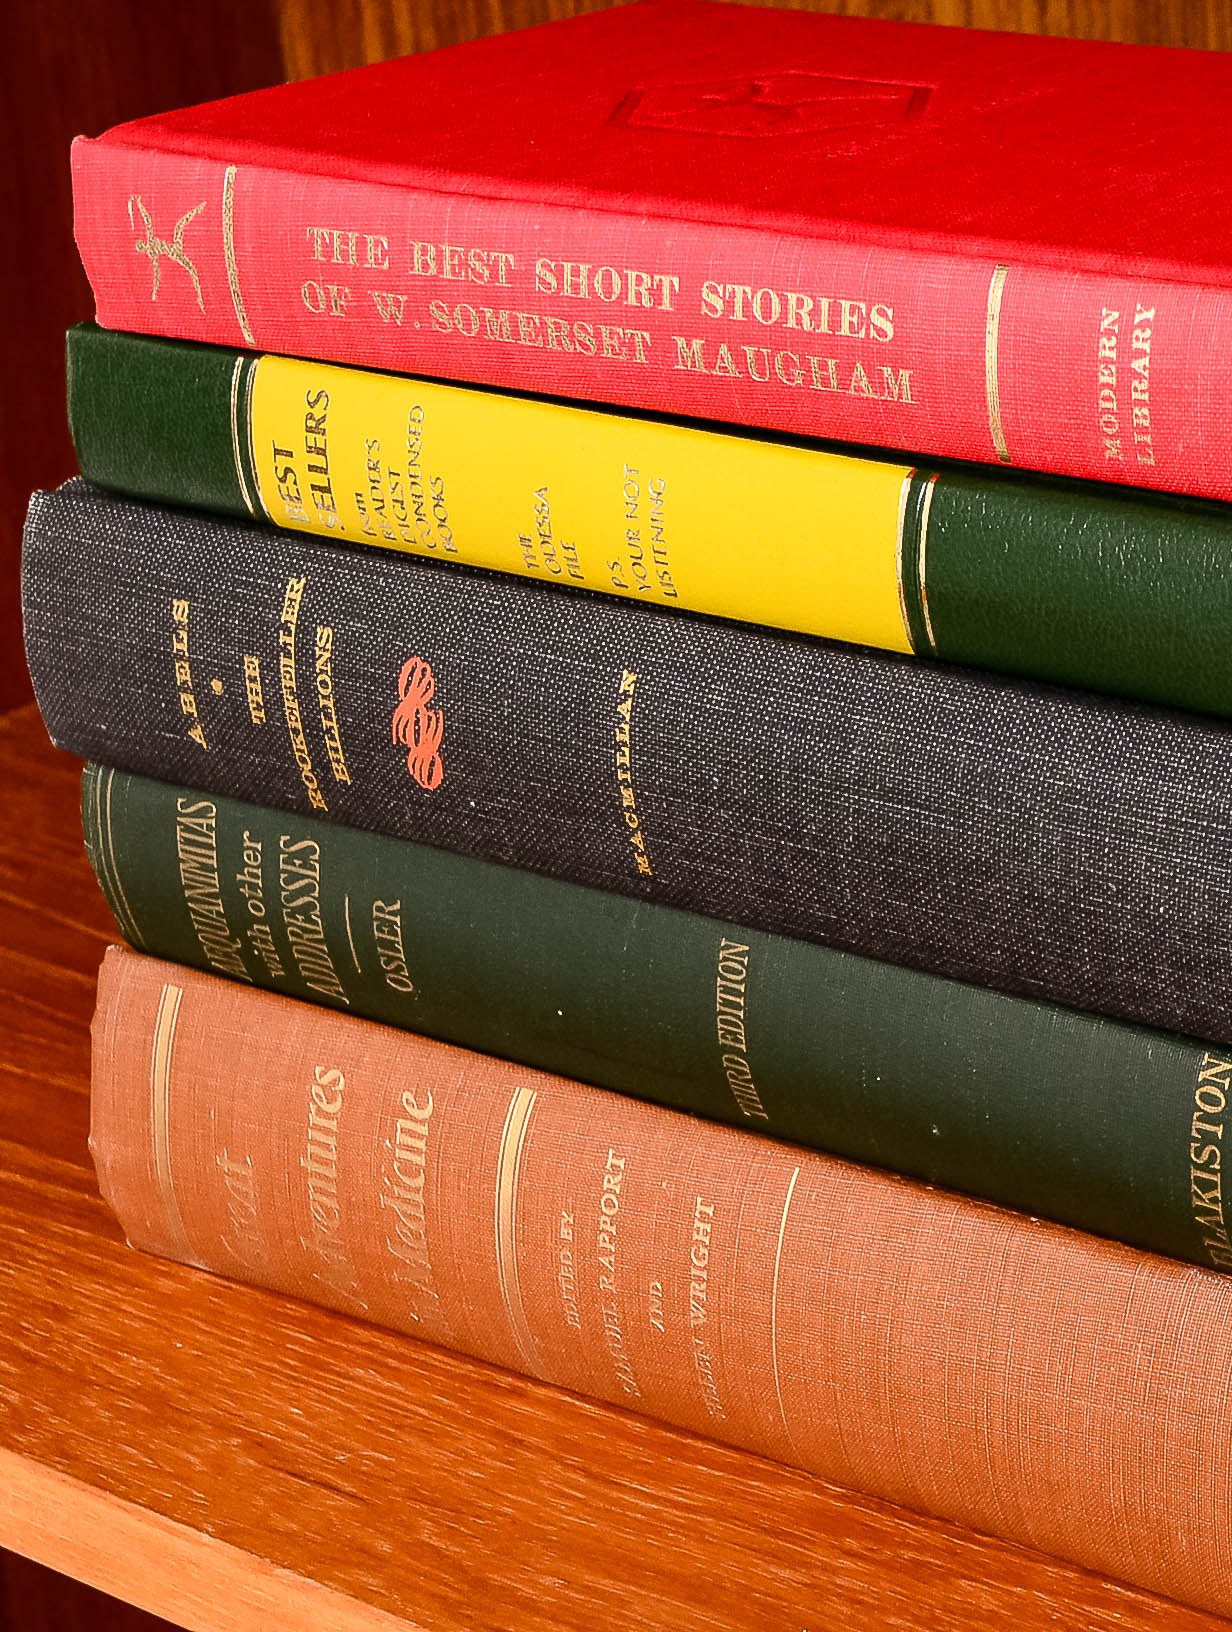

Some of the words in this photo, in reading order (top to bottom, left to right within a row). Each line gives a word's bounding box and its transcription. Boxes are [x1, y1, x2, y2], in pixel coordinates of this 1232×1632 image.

[306, 227, 389, 270] THE
[408, 240, 515, 287] BEST
[535, 257, 680, 312] SHORT
[701, 280, 895, 342] STORIES
[301, 279, 351, 317] OF
[671, 335, 920, 404] MAUGHAM
[1098, 307, 1124, 461] MODERN
[1131, 303, 1156, 466] LIBRARY
[272, 438, 311, 524] BEST
[304, 388, 346, 532] SELLERS
[365, 438, 398, 541] READER'S
[387, 466, 418, 545] DIGEST
[407, 405, 437, 549] CONDENSED
[429, 475, 459, 553] BOOKS
[623, 463, 640, 521] NOT
[518, 532, 540, 569] THE
[533, 486, 562, 575] ODESSA
[560, 540, 585, 580] FILE
[625, 528, 652, 592] YOUR
[648, 477, 679, 599] LISTENING
[172, 598, 208, 751] ABELS
[243, 654, 267, 724] THE
[279, 576, 329, 812] ROCKEFELLER
[316, 625, 352, 786] BILLIONS
[615, 668, 653, 877] MACMILLAN
[235, 830, 266, 918] other
[279, 834, 350, 1005] ADDRESSES
[372, 899, 414, 993] OSLER
[716, 936, 750, 1053] EDITION
[722, 1053, 769, 1120] THIRD
[560, 1209, 575, 1242] BY
[598, 1147, 627, 1294] RAPPORT
[689, 1196, 716, 1329] WRIGHT
[648, 1280, 665, 1334] AND
